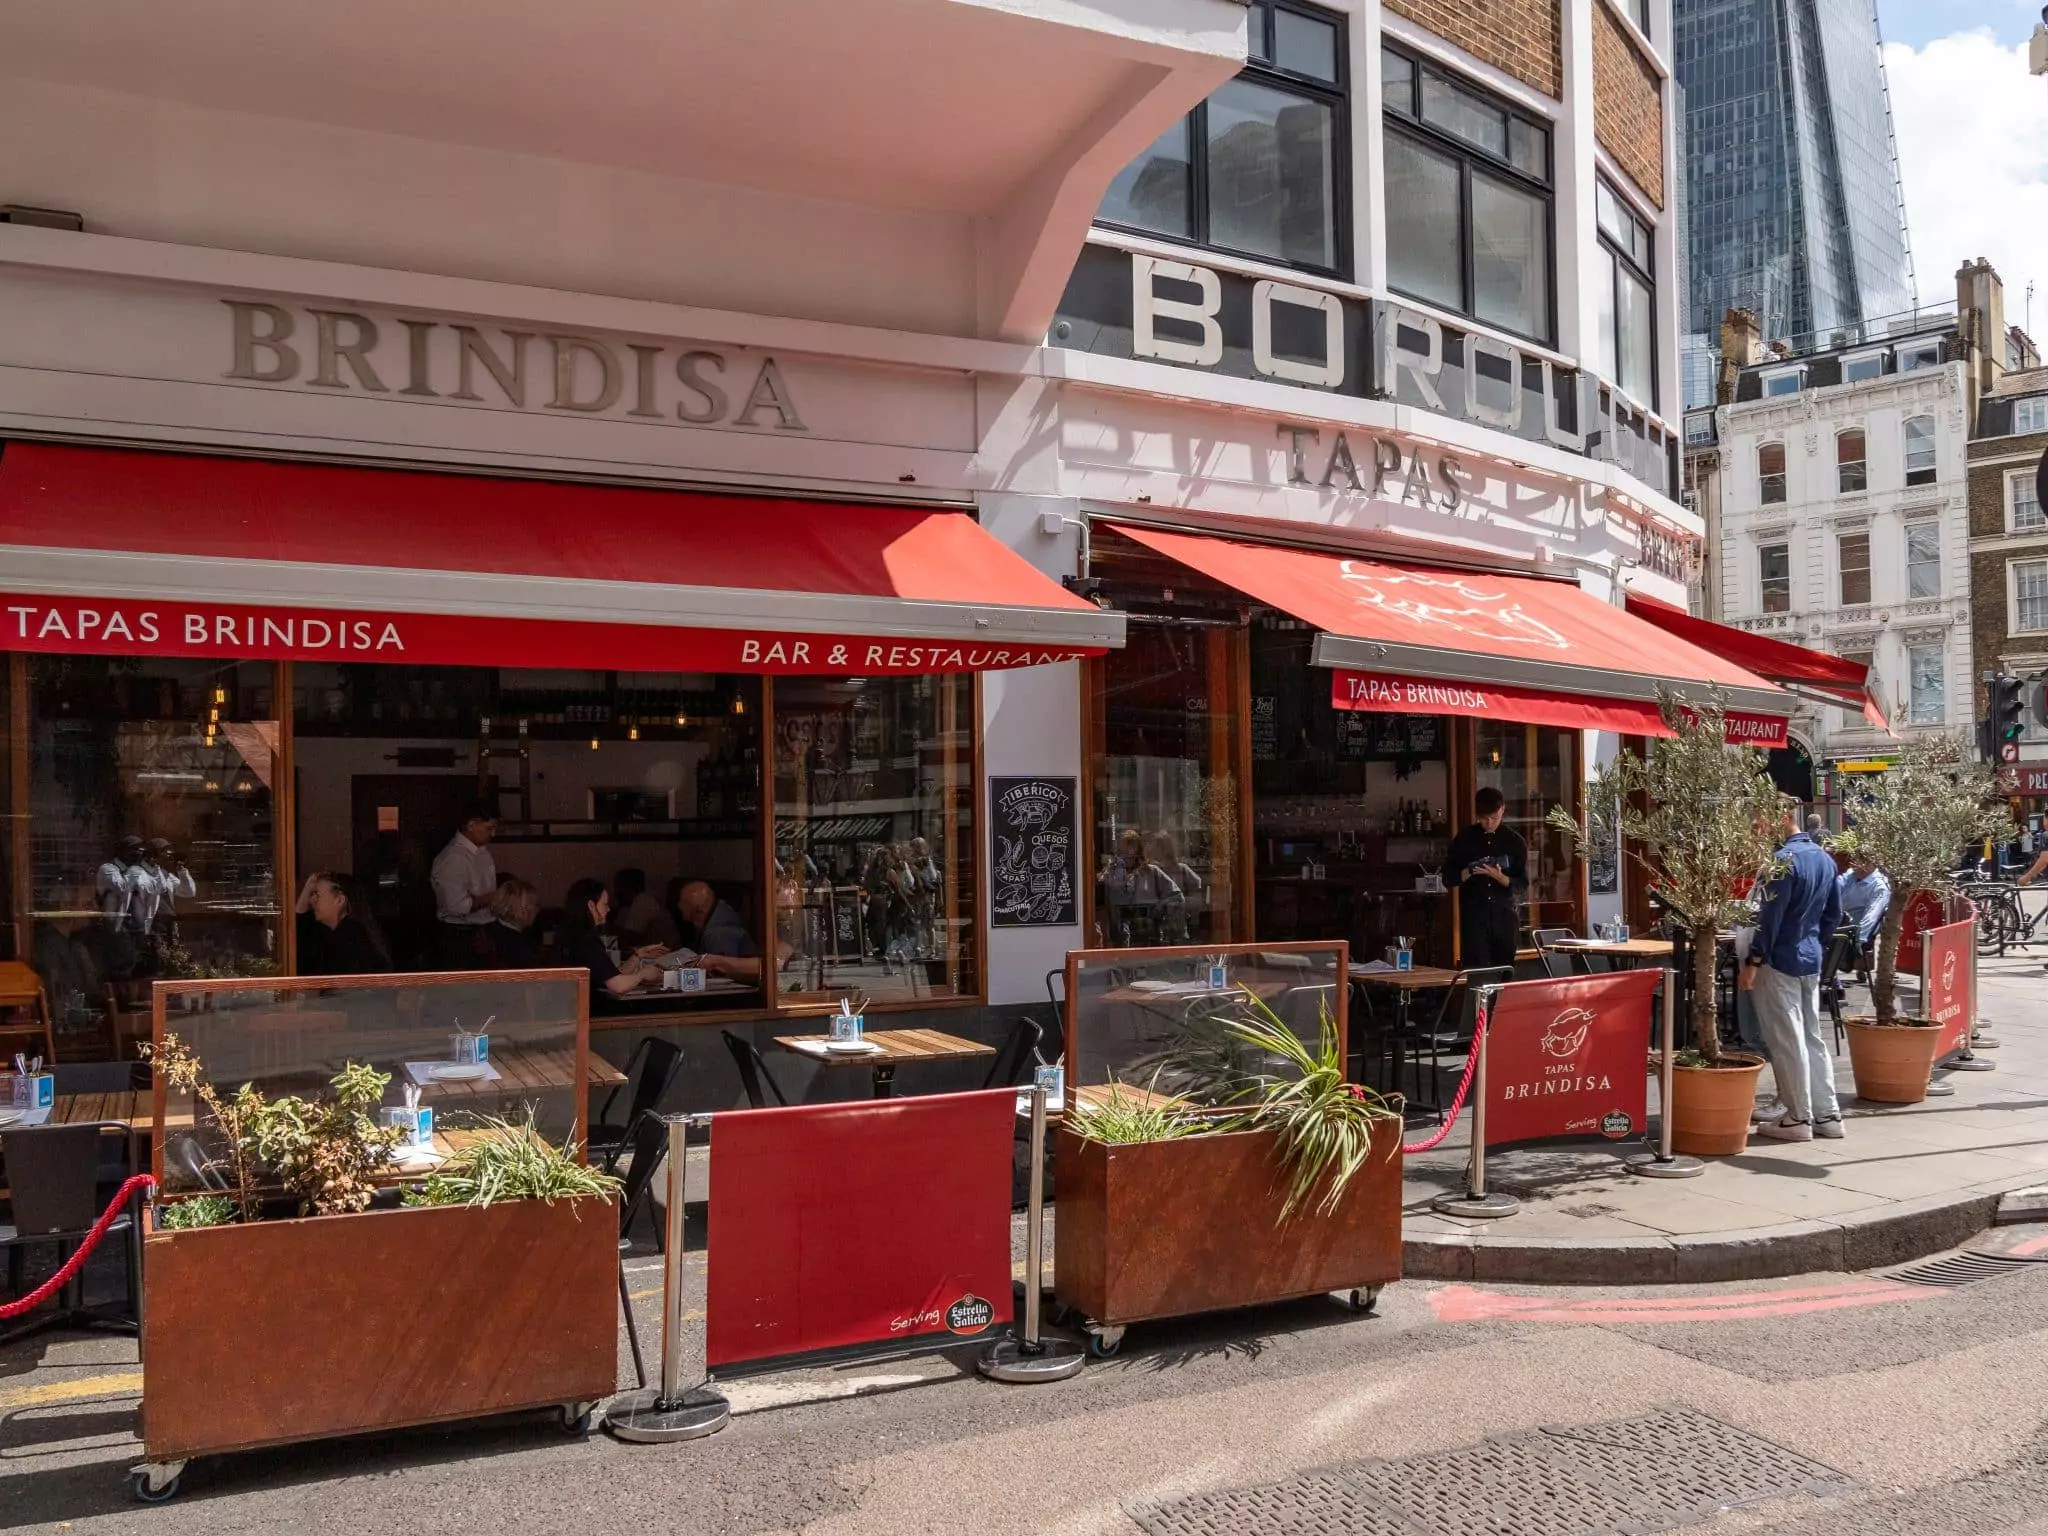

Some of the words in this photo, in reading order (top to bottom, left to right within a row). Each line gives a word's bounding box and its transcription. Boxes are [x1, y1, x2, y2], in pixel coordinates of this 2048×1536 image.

[220, 299, 809, 431] BRINDISA
[1277, 424, 1462, 511] TAPAS
[8, 606, 161, 643] TAPAS
[185, 613, 405, 651] BRINDISA
[741, 639, 812, 666] BAR
[827, 643, 849, 666] &
[1347, 678, 1401, 702] TAPAS
[1406, 683, 1489, 709] BRINDISA
[1032, 833, 1068, 846] QUESOS
[1544, 1063, 1575, 1075] TAPAS
[1504, 1075, 1612, 1100] BRINDISA
[1565, 1117, 1597, 1131] Serving
[890, 1309, 940, 1331] Serving
[951, 1303, 989, 1317] Estrella
[953, 1314, 987, 1328] Galicia
